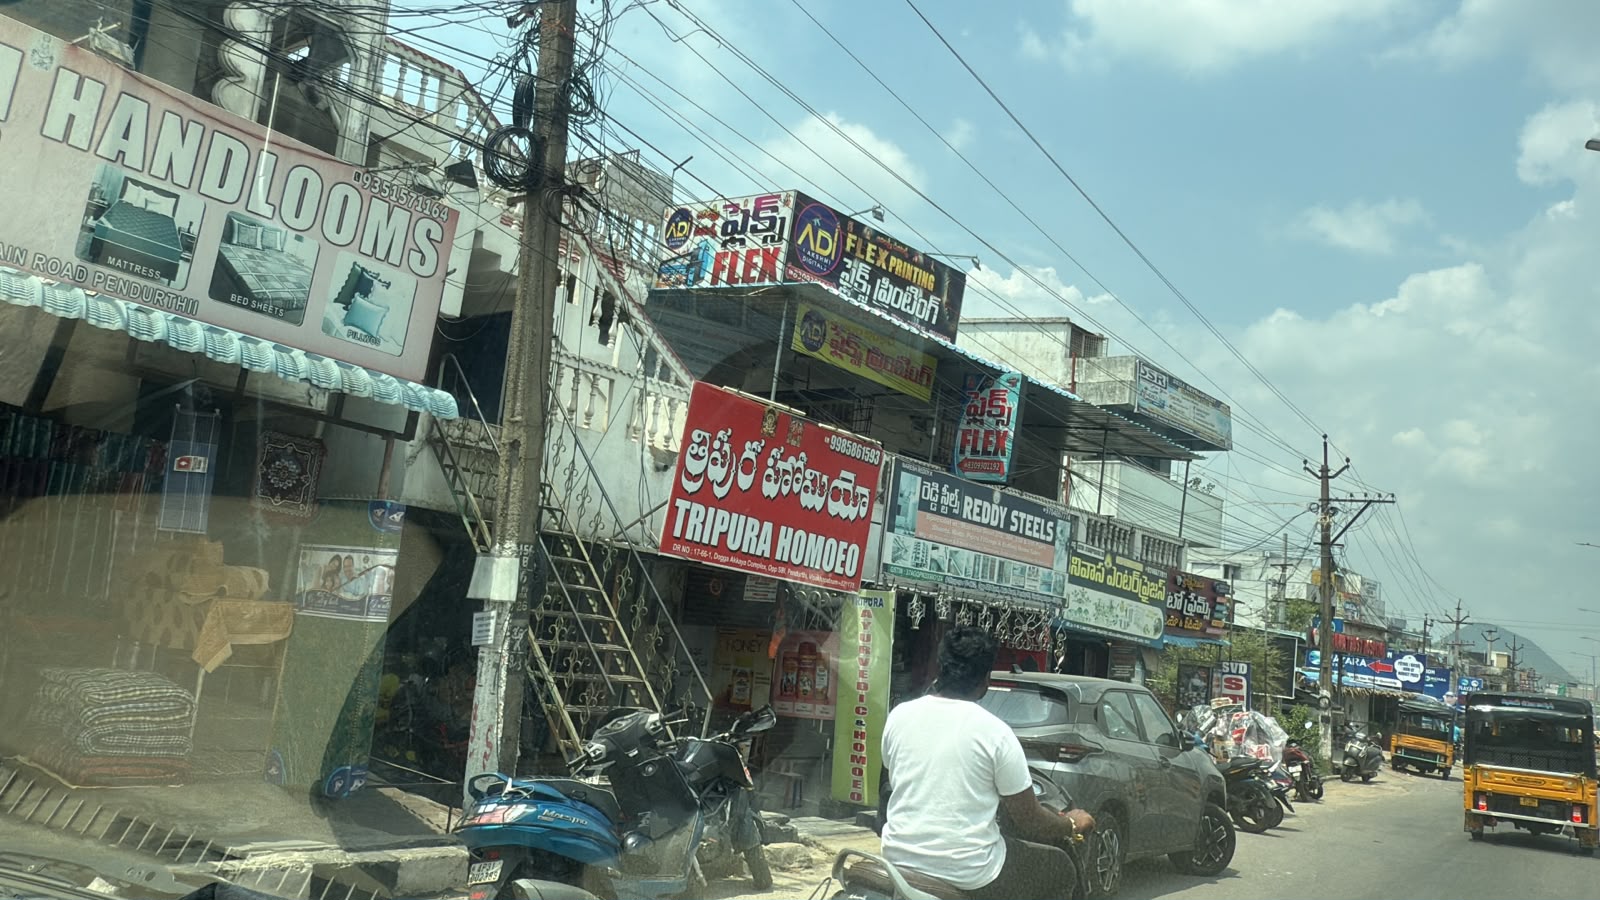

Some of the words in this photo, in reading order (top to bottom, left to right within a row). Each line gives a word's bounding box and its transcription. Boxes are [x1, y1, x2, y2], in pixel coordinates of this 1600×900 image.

[40, 65, 445, 279] HANDLOOMS
[361, 172, 450, 222] 9351571164
[107, 255, 161, 280] MATTRESS
[710, 247, 782, 286] FLEX
[845, 232, 887, 270] FLEX
[889, 255, 936, 292] PRINTING
[32, 252, 89, 283] ROAD
[92, 271, 200, 316] PENDURTHII
[230, 293, 249, 306] BED
[251, 300, 284, 317] SHEETS
[1140, 362, 1166, 387] SSR
[681, 428, 765, 500] త్రిపుర
[830, 434, 881, 465] 9985861593
[958, 429, 1009, 456] FLEX
[672, 498, 774, 559] TRIPURA
[775, 525, 860, 577] HOMOEO
[962, 495, 1007, 528] REDDY
[1010, 509, 1054, 542] STEELS
[681, 544, 690, 552] NO
[855, 609, 873, 716] AYURVEDIC
[1222, 662, 1248, 674] SVD
[849, 729, 867, 802] HOMOEO
[543, 809, 588, 826] Maestro
